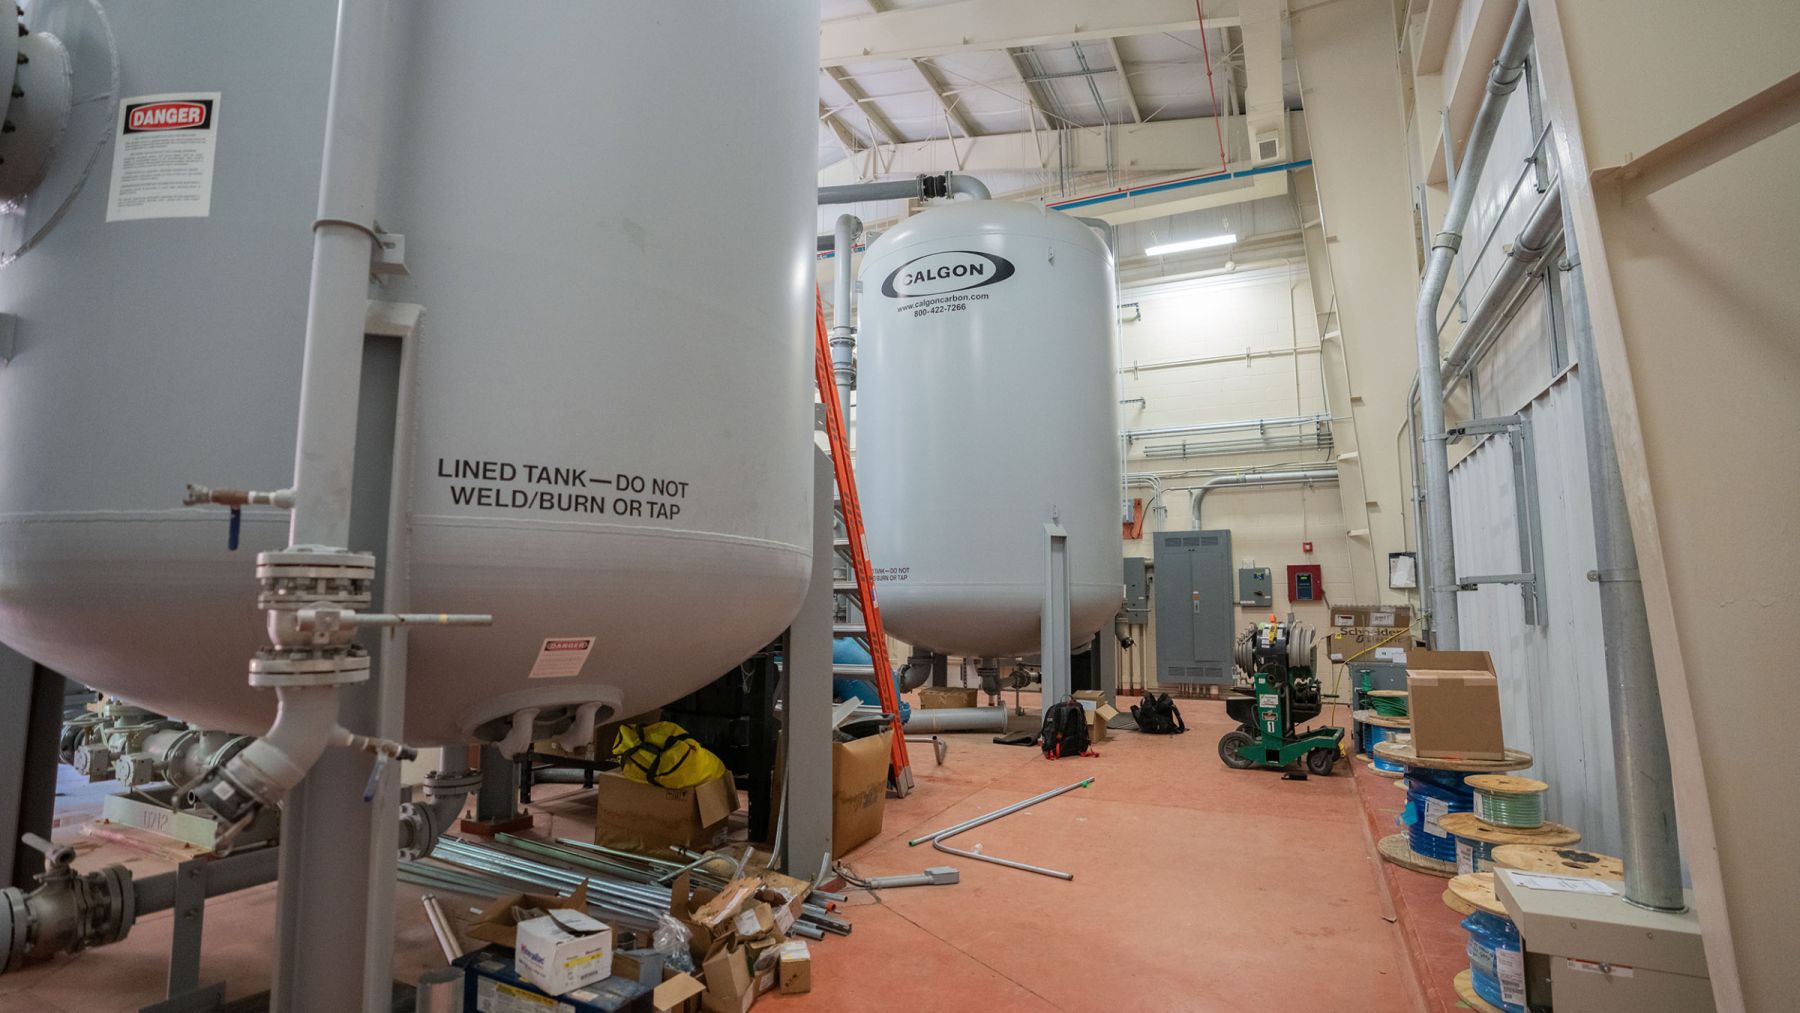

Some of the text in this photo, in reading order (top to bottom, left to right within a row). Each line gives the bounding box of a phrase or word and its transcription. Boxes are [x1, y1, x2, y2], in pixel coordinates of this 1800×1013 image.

[133, 107, 201, 127] DANGER
[903, 263, 984, 286] CALGON
[897, 293, 989, 313] www.calgoncarbon.com
[914, 303, 967, 318] 800-422-7266
[438, 458, 517, 482] LINED
[652, 479, 689, 499] NOT
[450, 486, 681, 520] WELD/BURN OR TAP
